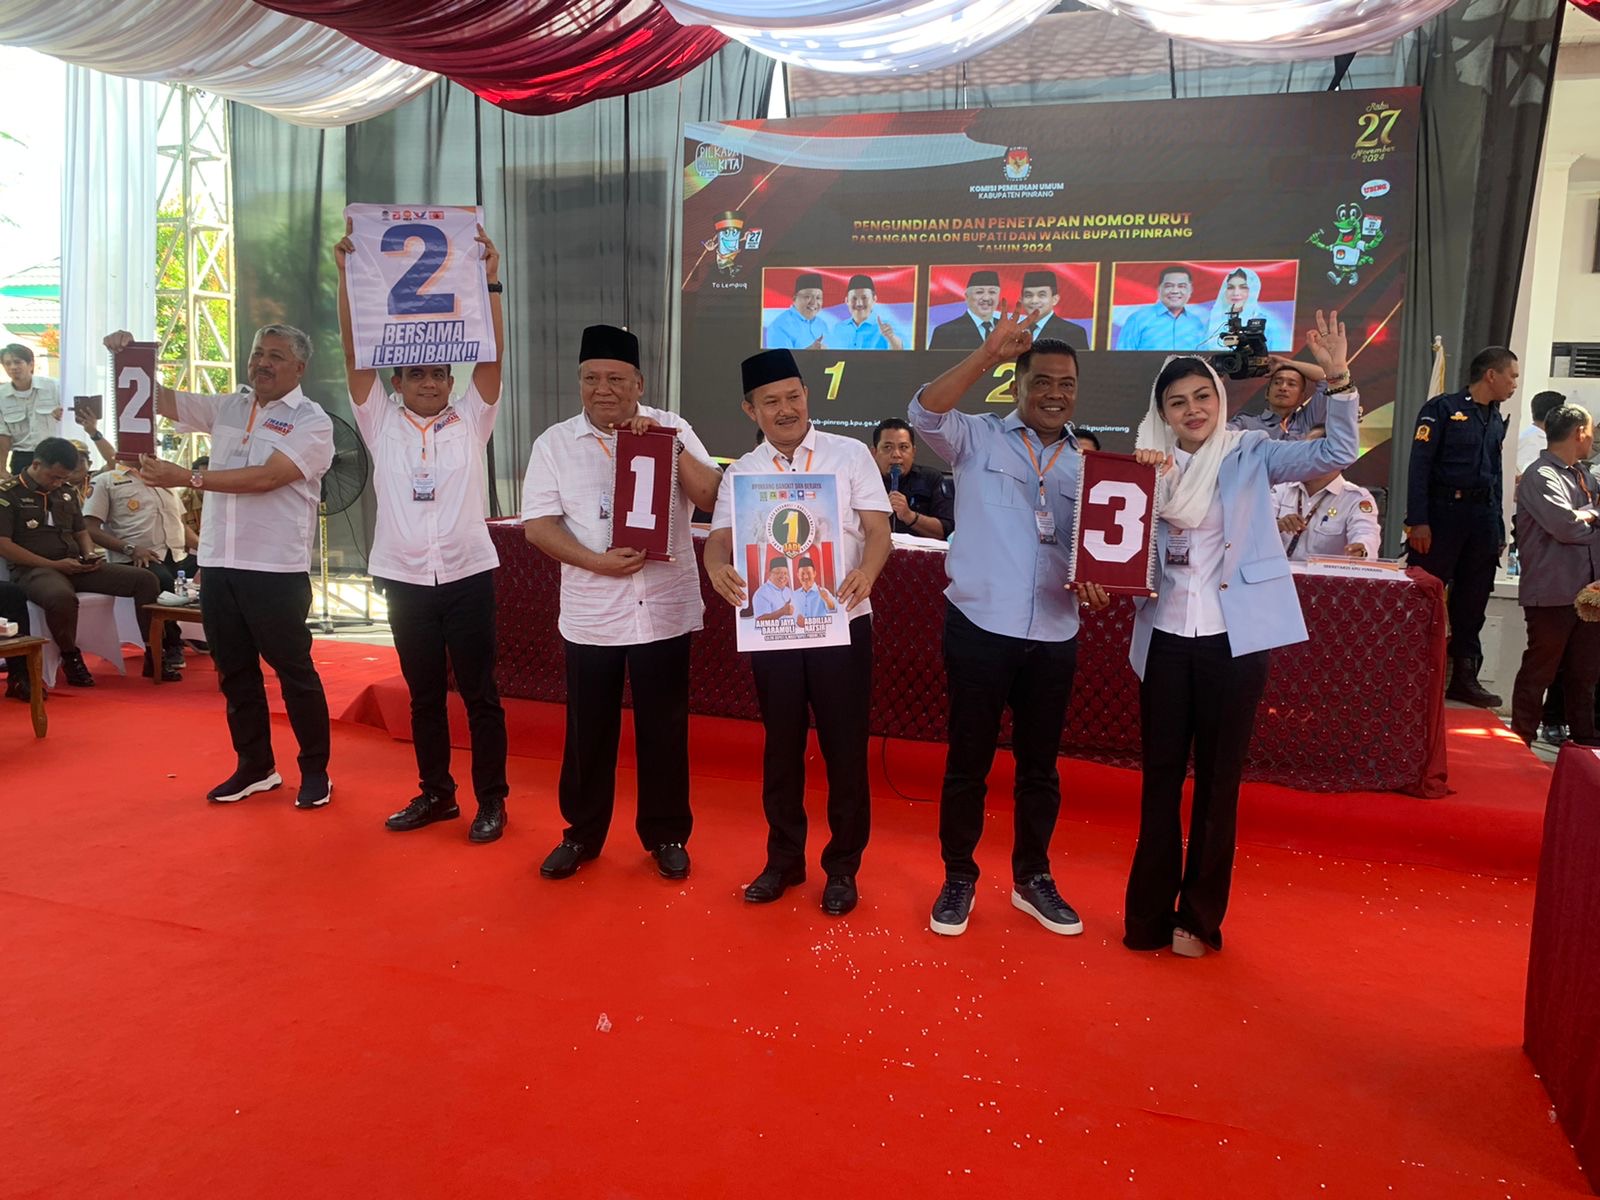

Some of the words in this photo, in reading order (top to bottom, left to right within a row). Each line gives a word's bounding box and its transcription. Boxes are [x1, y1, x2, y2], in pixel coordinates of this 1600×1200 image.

[1355, 109, 1402, 148] 27
[718, 158, 740, 170] KITA
[1351, 145, 1396, 160] November
[969, 185, 997, 193] KOMISI
[998, 184, 1039, 192] PEMILIHAN
[1039, 182, 1065, 190] UMUM
[978, 191, 1020, 200] KABUPATEN
[1021, 190, 1054, 198] PINRANG
[853, 219, 949, 232] PENGUNDIAN
[952, 217, 985, 230] DAN
[988, 216, 1080, 229] PENETAPAN
[1083, 213, 1146, 227] NOMOR
[1148, 212, 1193, 225] URUT
[919, 233, 961, 243] CALON
[962, 231, 1007, 242] BUPATI
[1009, 231, 1037, 241] DAN
[1040, 230, 1081, 241] WAKIL
[1083, 229, 1130, 240] BUPATI
[1132, 227, 1193, 239] PINRANG
[977, 244, 1020, 252] TAHUN
[1022, 243, 1053, 253] 2024
[381, 223, 455, 316] 2
[384, 320, 464, 345] BERSAMA
[373, 345, 424, 366] LEBIH
[423, 343, 464, 363] BAIK
[823, 361, 846, 400] 1
[985, 362, 1017, 402] 2
[118, 366, 152, 433] 2
[1079, 424, 1130, 433] @kpupinrang
[626, 455, 656, 530] 1
[782, 510, 799, 544] 1
[1083, 480, 1148, 563] 3
[756, 619, 780, 628] AHMAD
[780, 618, 795, 626] JAYA
